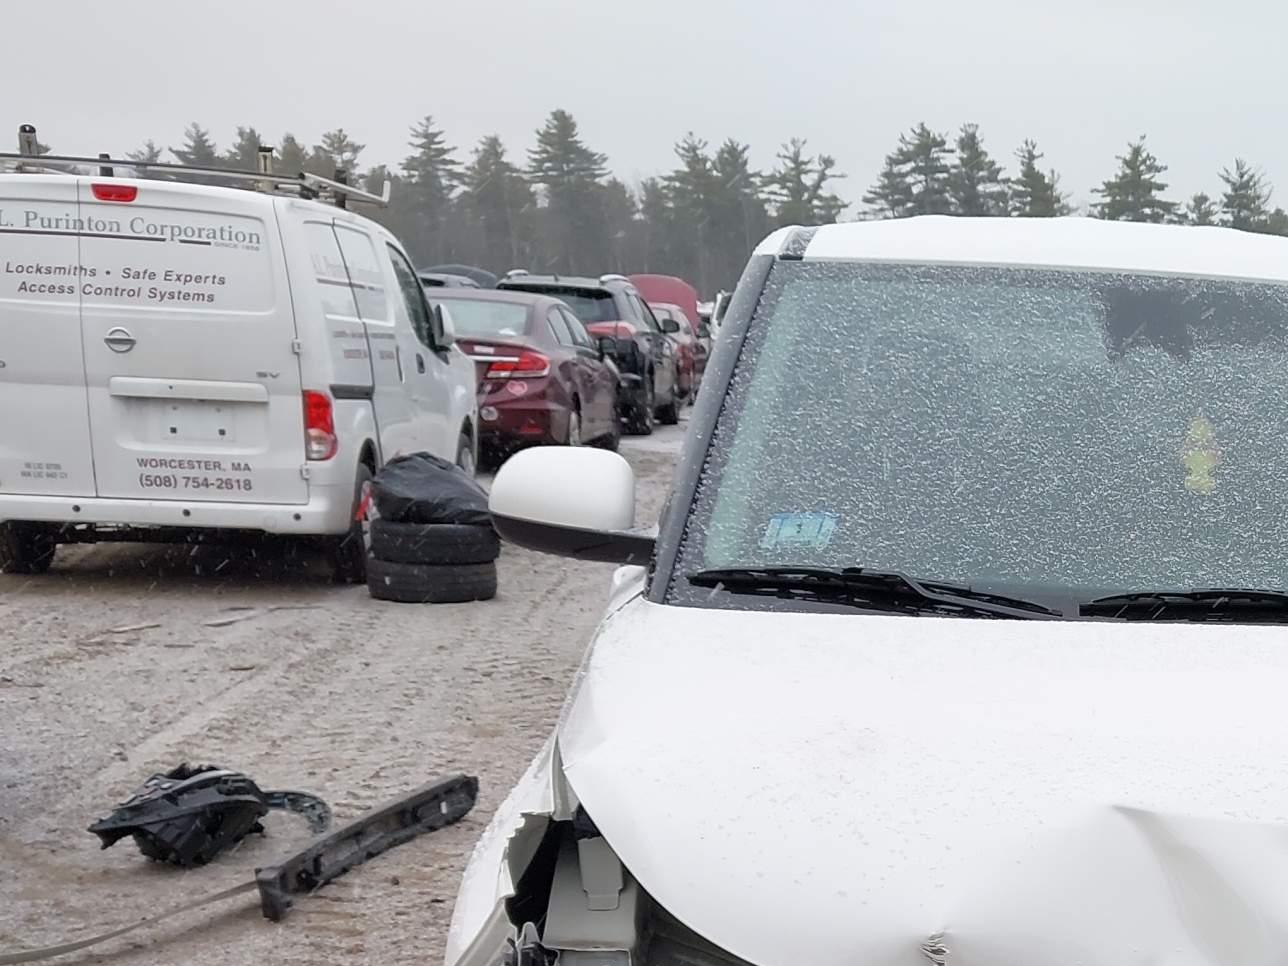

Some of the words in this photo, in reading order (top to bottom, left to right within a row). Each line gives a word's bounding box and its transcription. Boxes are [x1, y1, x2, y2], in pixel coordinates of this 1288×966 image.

[24, 210, 121, 233] Purinton
[130, 217, 261, 245] Corporation
[5, 262, 97, 278] Locksmiths
[121, 267, 157, 281] Safe
[163, 270, 226, 285] Experts
[17, 281, 75, 295] Access
[82, 284, 141, 298] Control
[148, 288, 215, 303] Systems
[136, 458, 227, 472] WORCESTER,
[231, 462, 252, 472] MA
[139, 473, 178, 489] (508)
[182, 476, 252, 491] 754-2618
